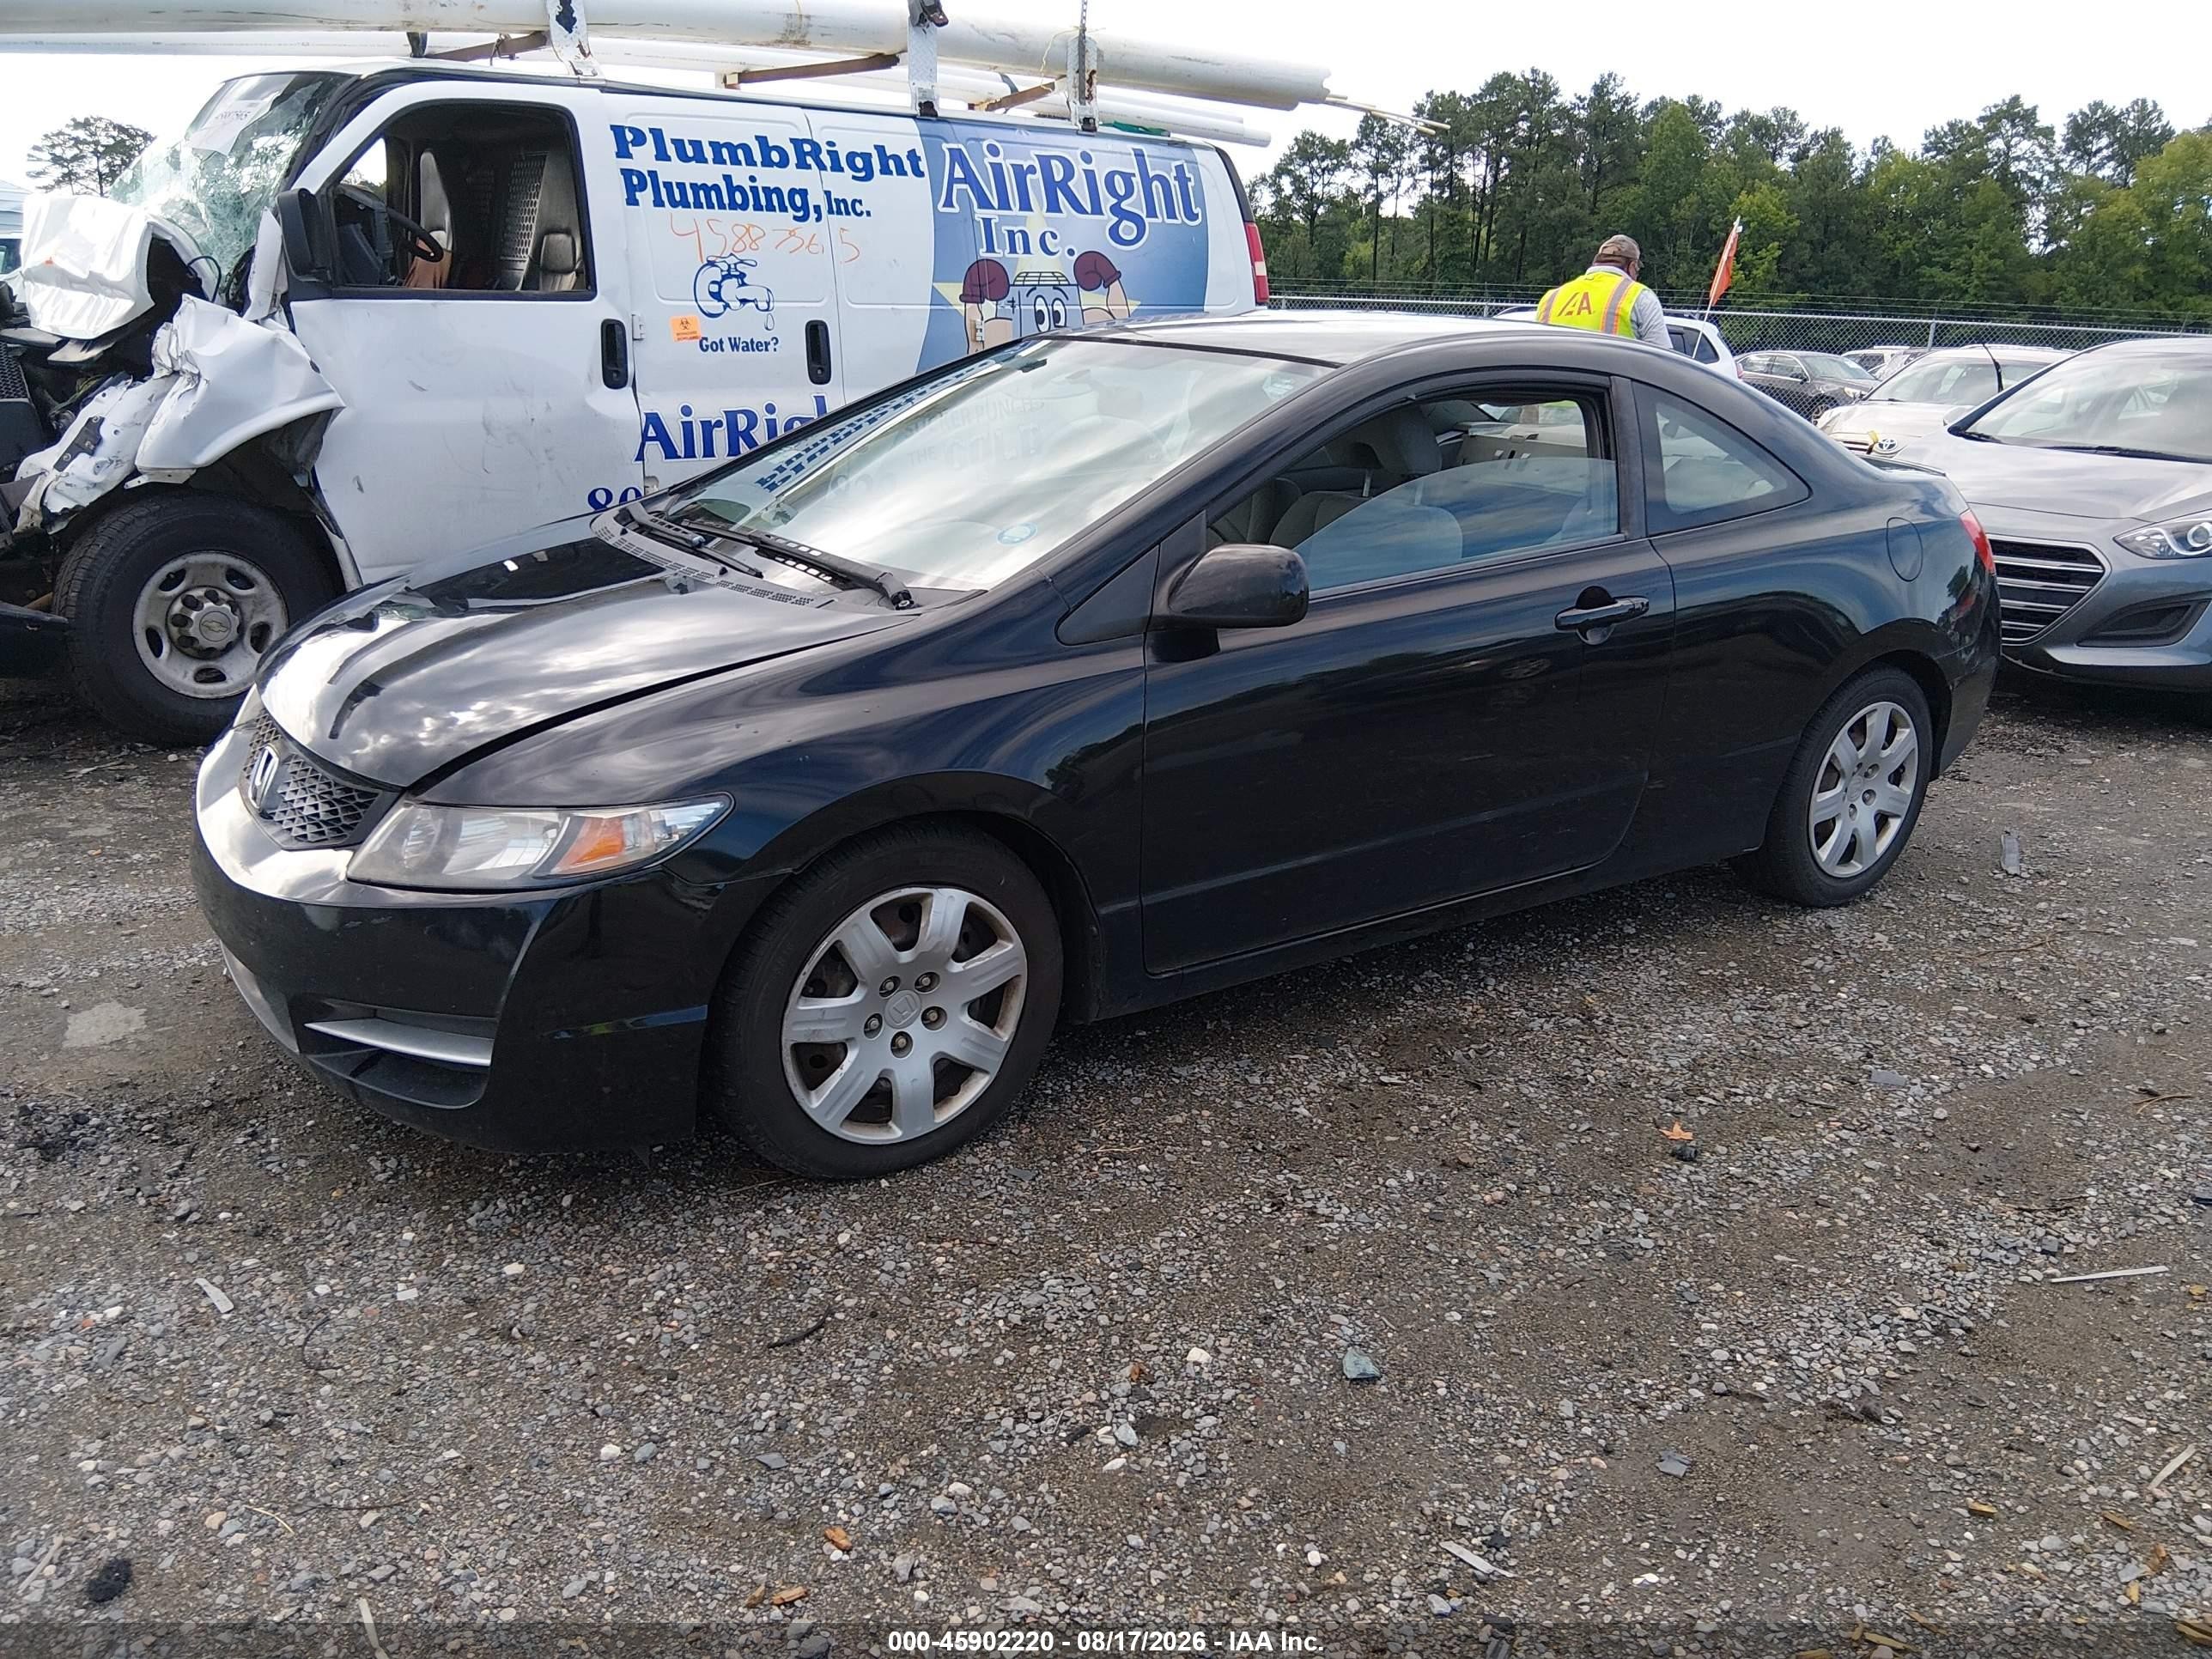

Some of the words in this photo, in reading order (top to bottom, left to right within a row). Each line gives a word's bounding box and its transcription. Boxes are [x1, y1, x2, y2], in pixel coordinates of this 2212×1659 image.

[610, 124, 925, 182] PlumbRight
[620, 167, 823, 222] Plumbing,
[825, 190, 872, 218] Inc.
[939, 140, 1200, 248] AirRight
[976, 214, 1077, 257] Inc.
[699, 337, 725, 353] Got
[727, 337, 779, 353] Water?
